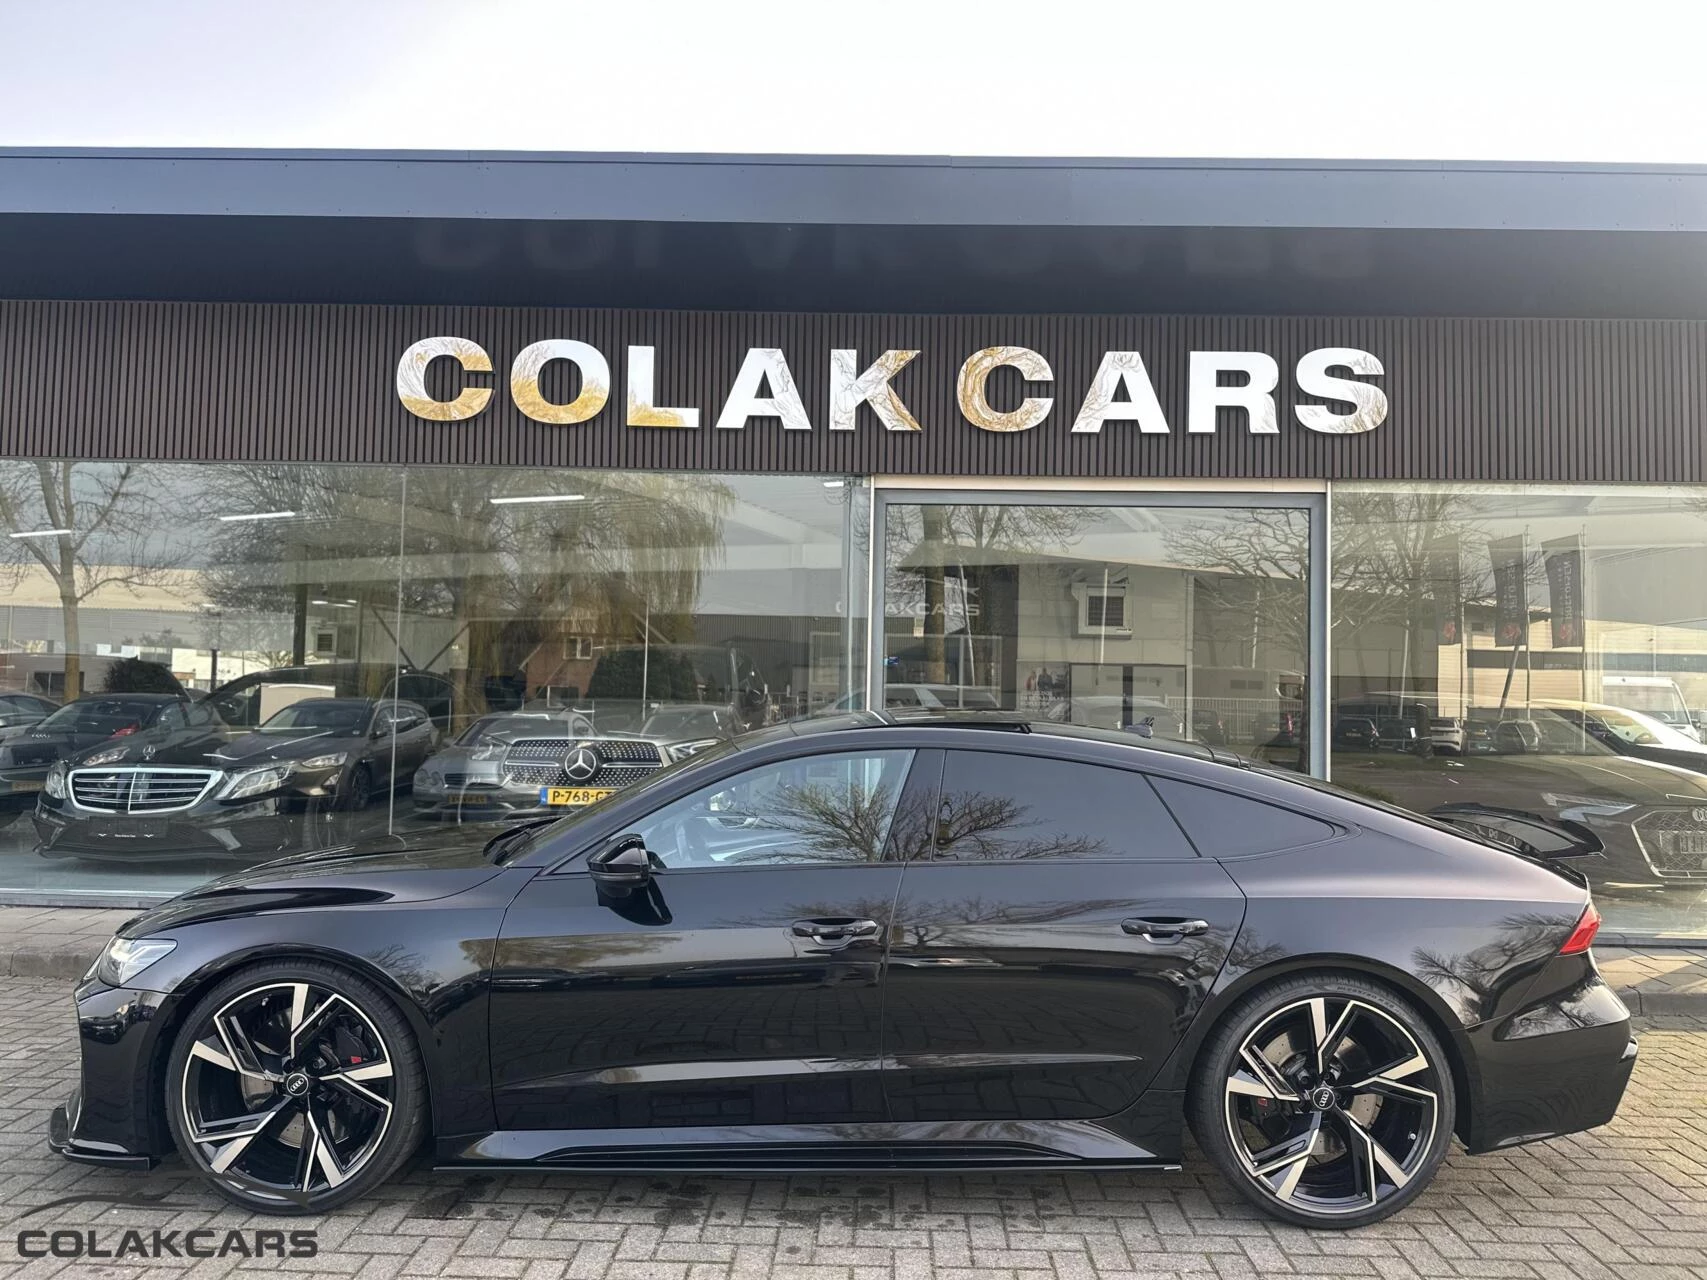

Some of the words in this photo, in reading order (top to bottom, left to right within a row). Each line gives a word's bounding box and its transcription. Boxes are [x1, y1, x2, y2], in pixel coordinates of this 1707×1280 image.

[396, 336, 923, 433] COLAK
[956, 346, 1389, 435] CARS
[884, 602, 980, 616] AKCARS
